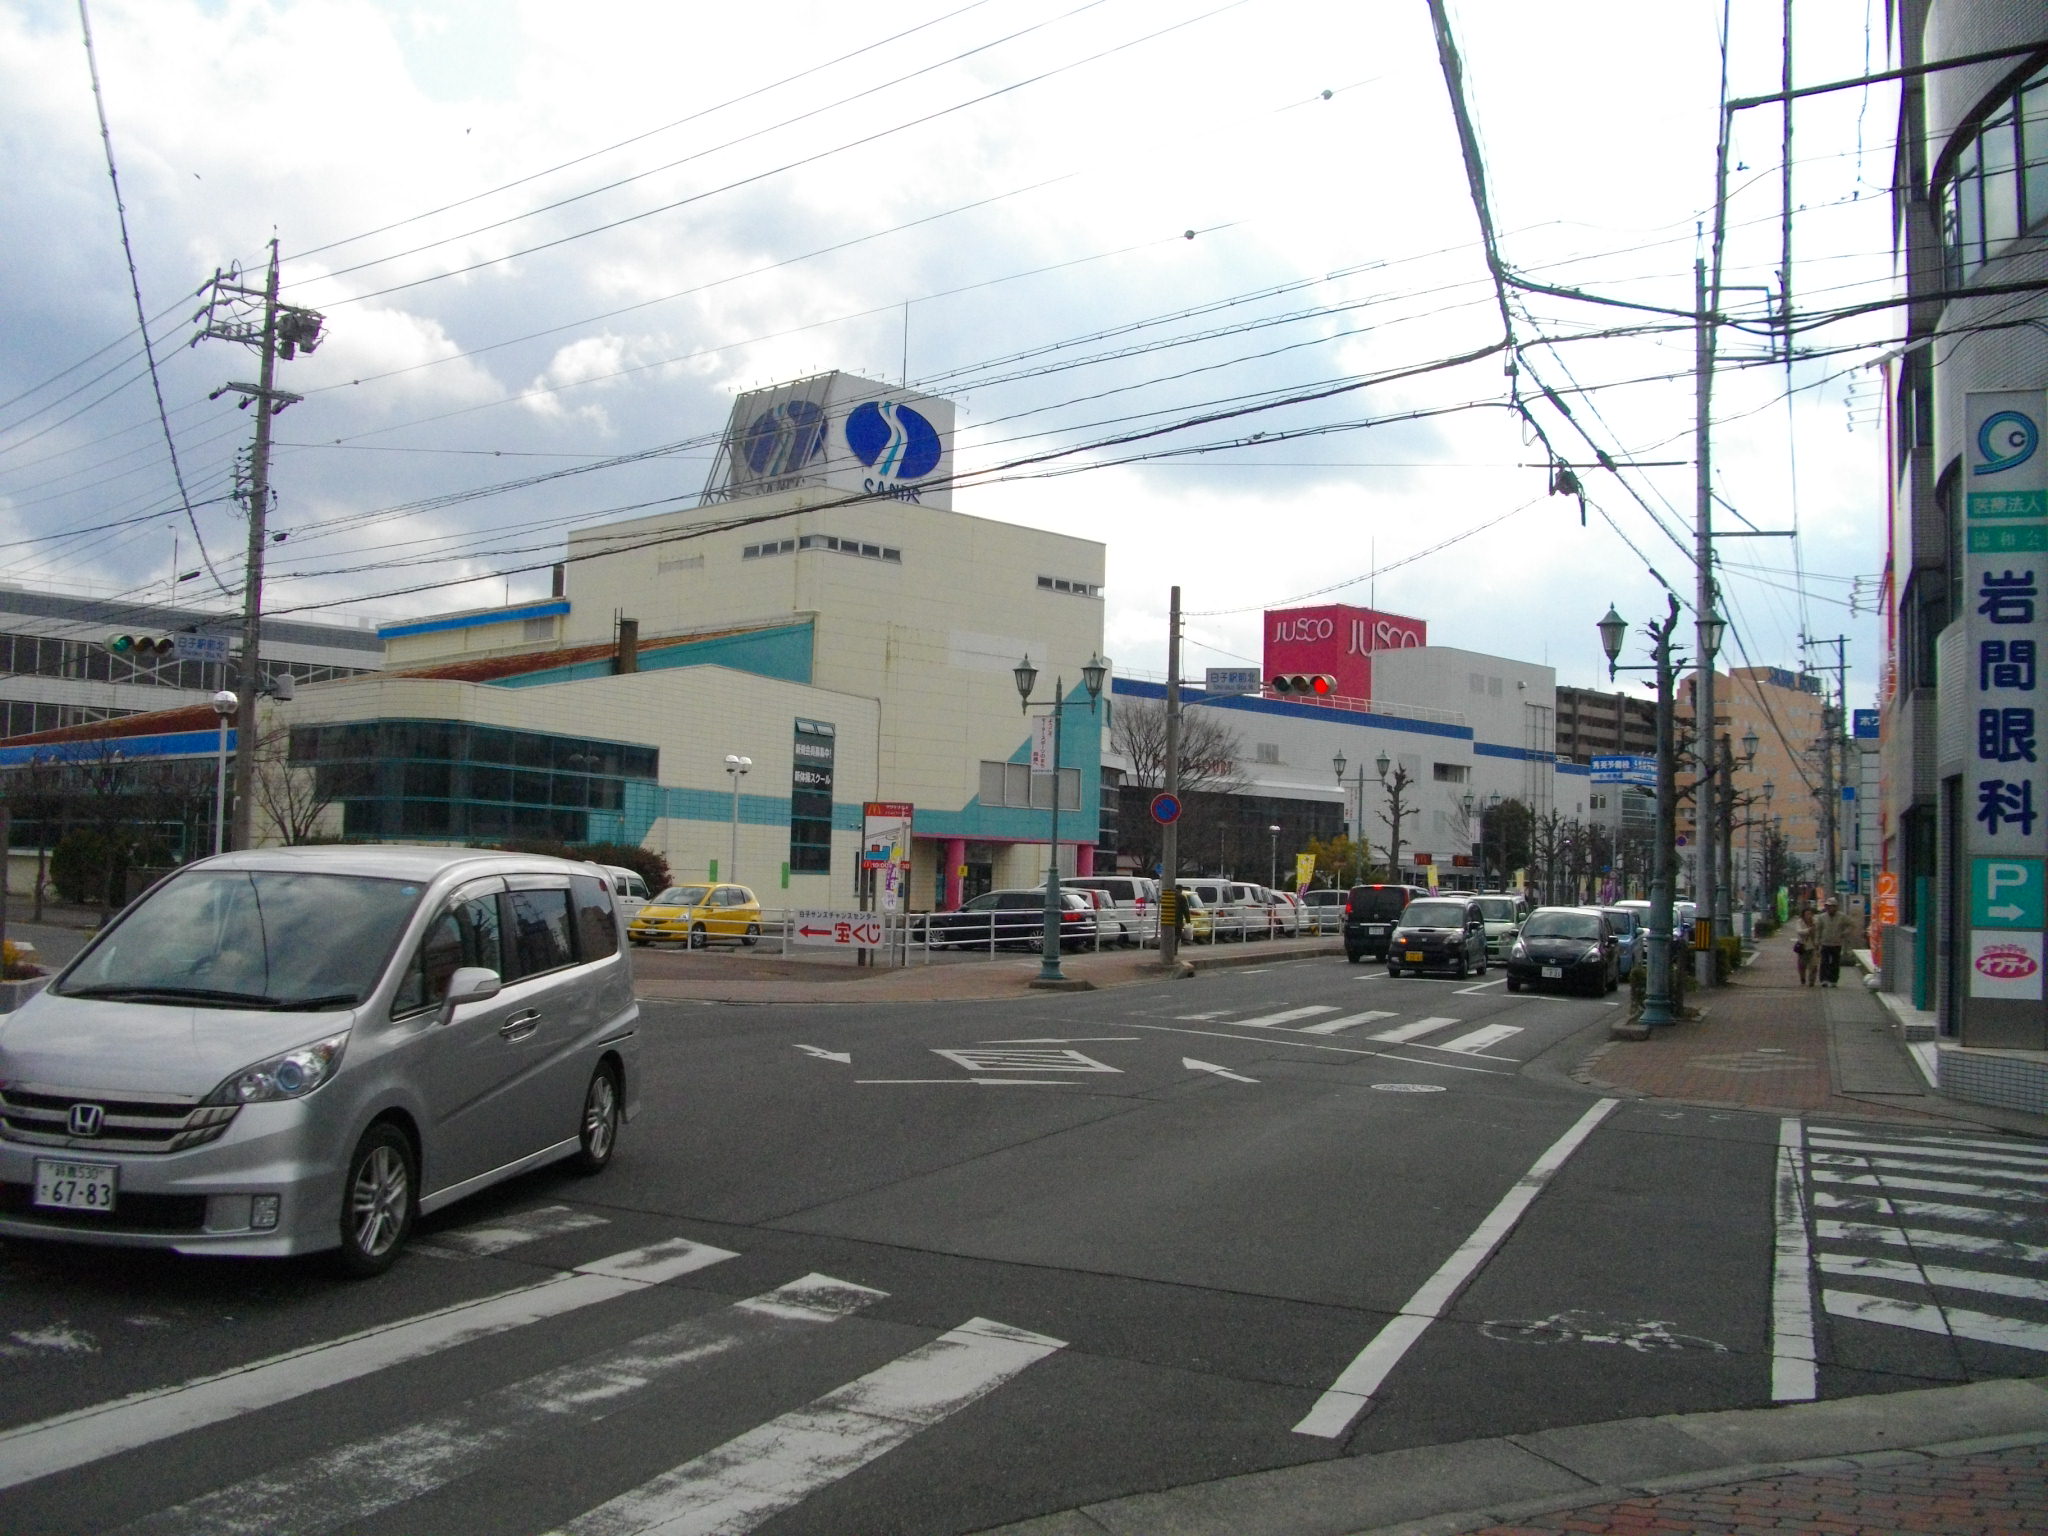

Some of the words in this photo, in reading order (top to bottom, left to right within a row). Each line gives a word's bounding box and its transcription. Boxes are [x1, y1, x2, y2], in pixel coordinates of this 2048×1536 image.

[1974, 496, 2041, 514] 医療法人
[1273, 617, 1334, 643] JUSCO
[1210, 671, 1256, 683] 白子駅前北
[1977, 569, 2039, 836] 岩間眼科
[1988, 863, 2028, 900] P
[834, 921, 881, 944] 宝くじ
[53, 1180, 110, 1206] 67-83
